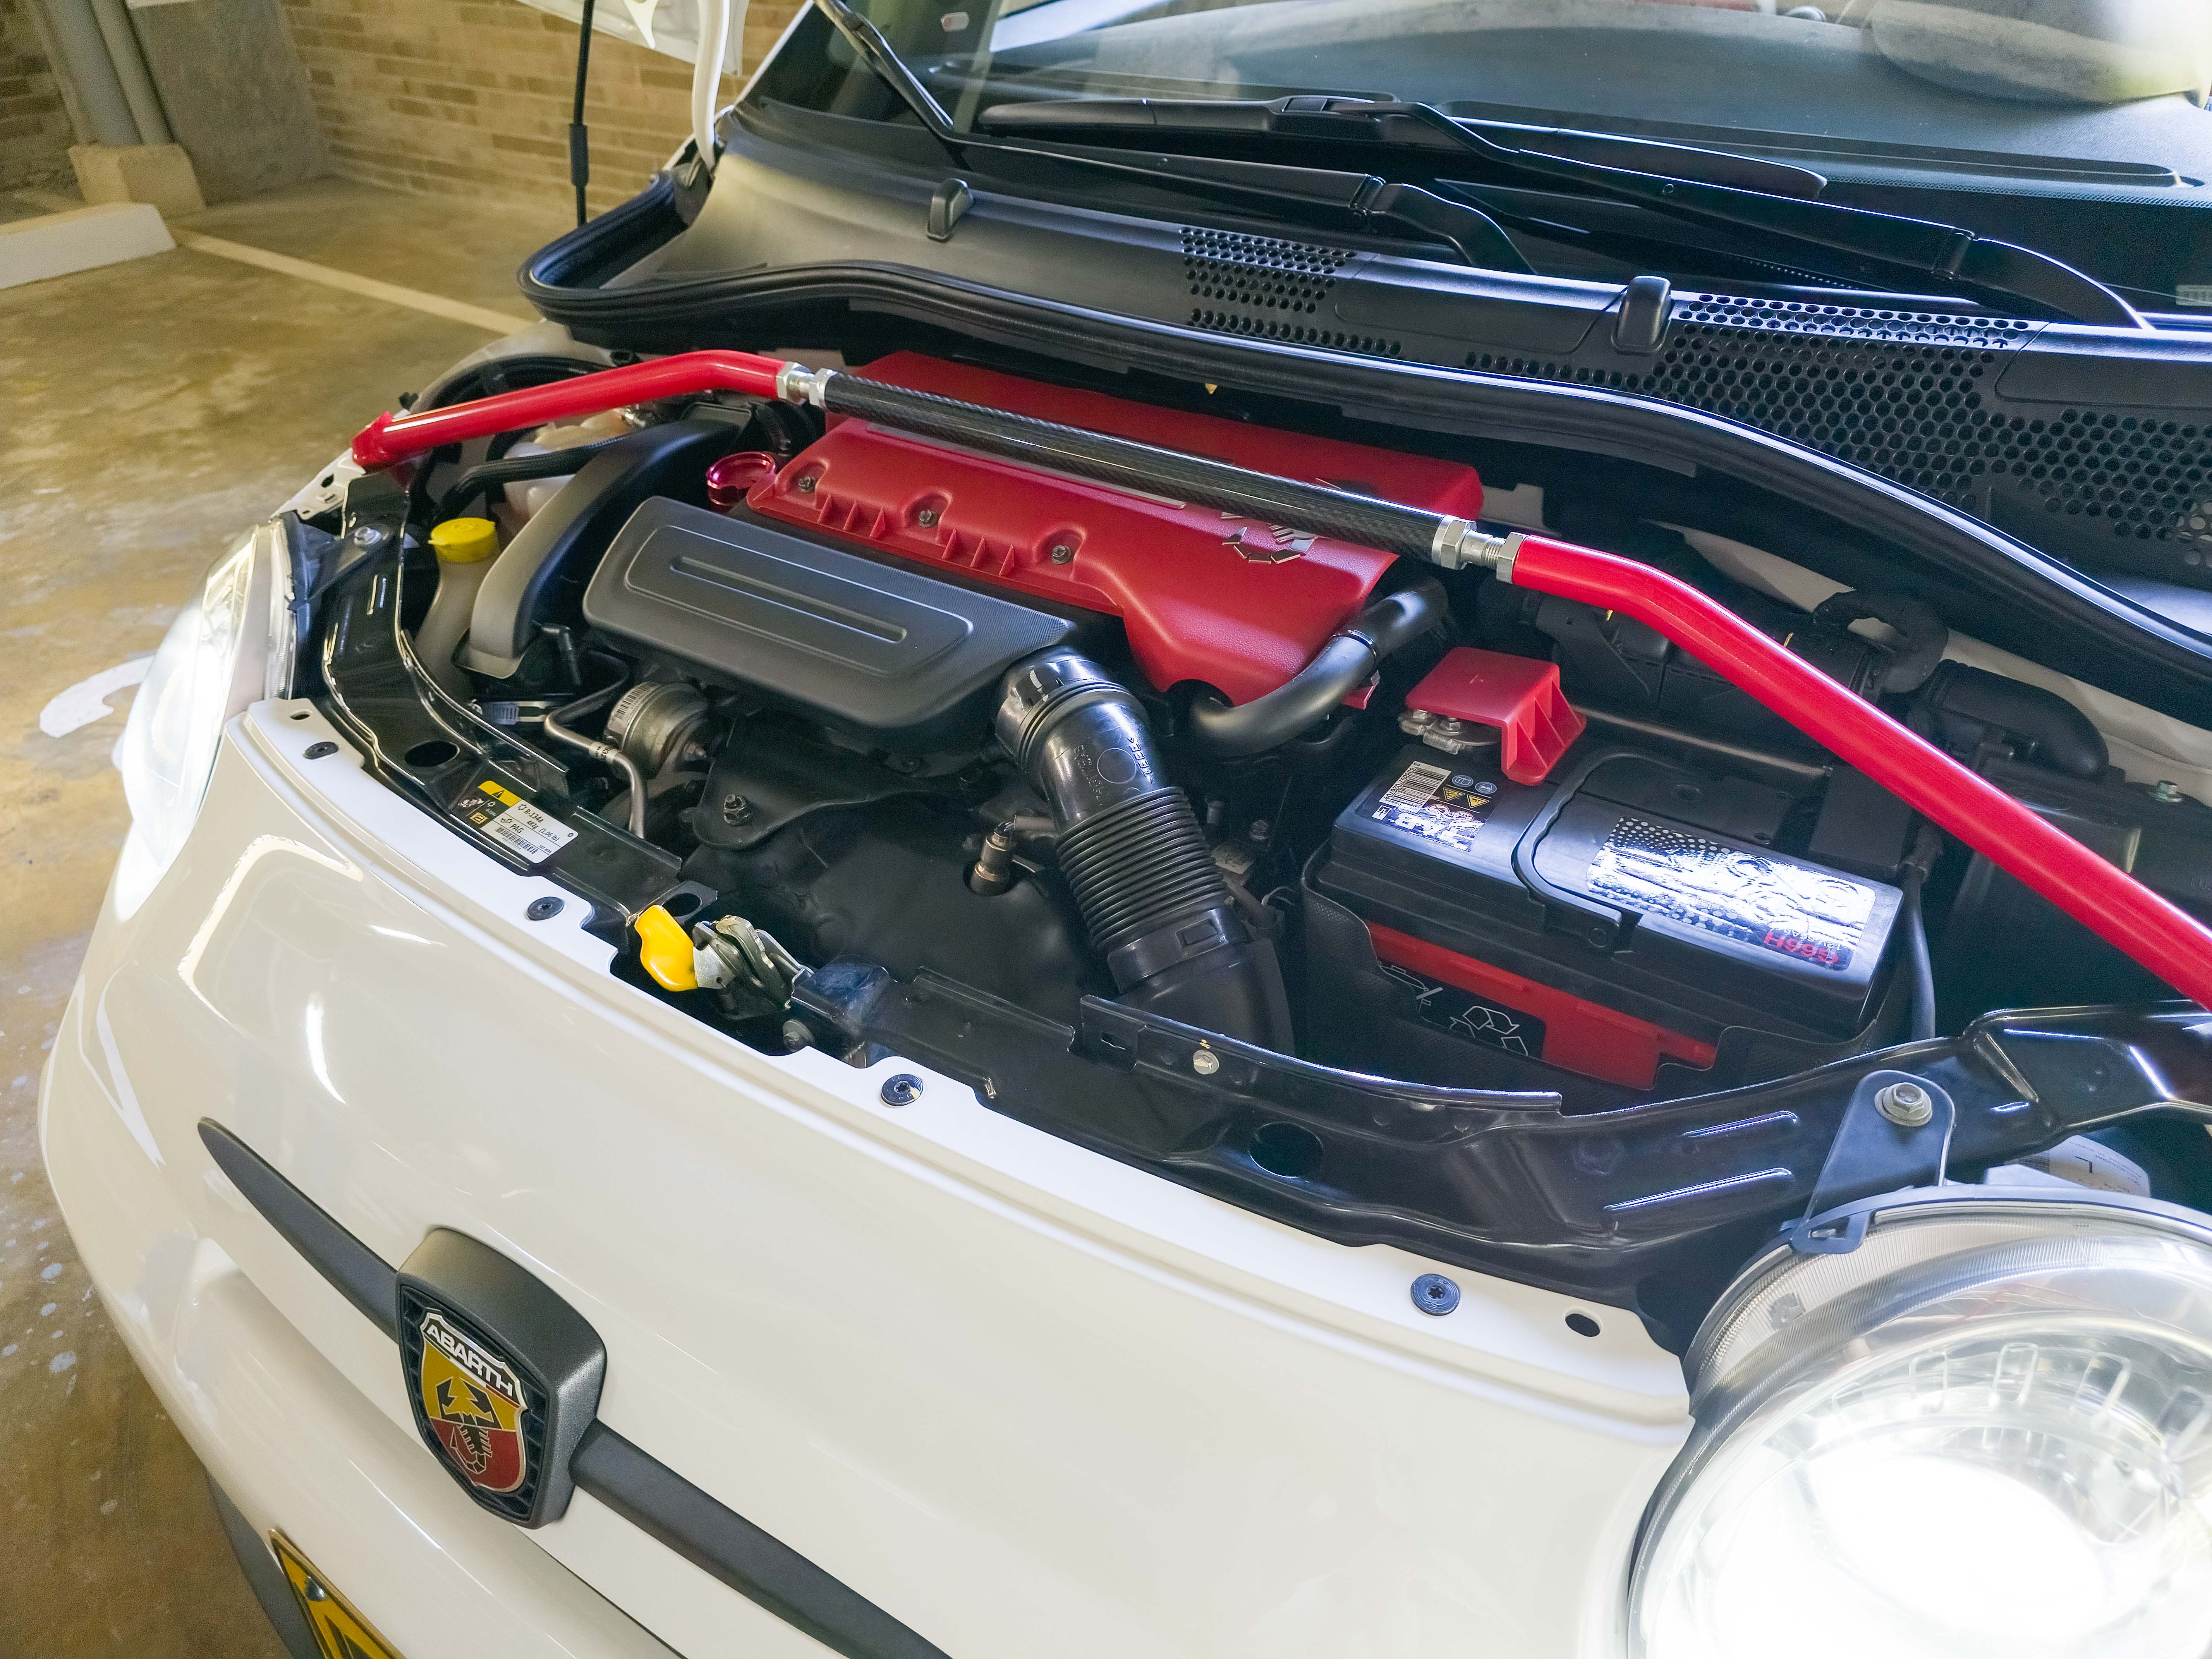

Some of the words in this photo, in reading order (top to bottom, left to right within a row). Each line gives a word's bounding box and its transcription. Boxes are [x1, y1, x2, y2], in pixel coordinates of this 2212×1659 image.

[1399, 768, 1416, 784] 838807
[1384, 783, 1402, 800] 026704
[524, 809, 544, 823] R-134a
[510, 824, 524, 833] PAG
[426, 1324, 514, 1396] ABARTH
